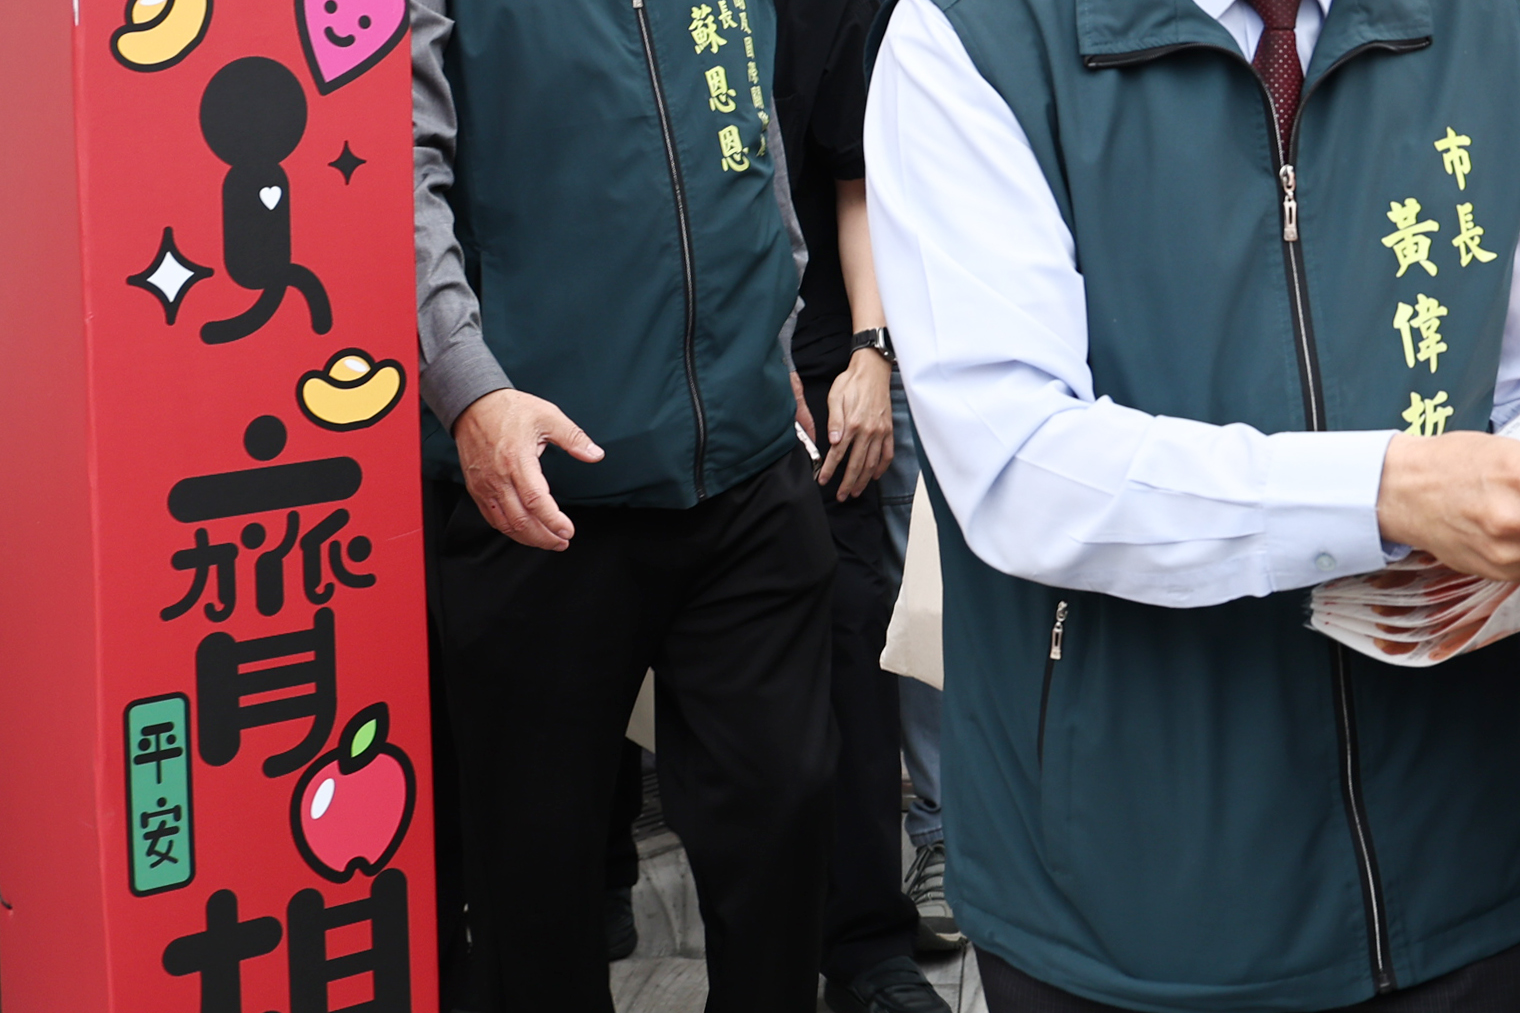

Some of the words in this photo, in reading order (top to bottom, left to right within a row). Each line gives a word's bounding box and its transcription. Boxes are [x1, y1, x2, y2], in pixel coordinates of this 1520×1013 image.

[688, 3, 751, 172] 蘇恩恩
[1434, 126, 1498, 268] 市長
[133, 721, 184, 868] 平安
